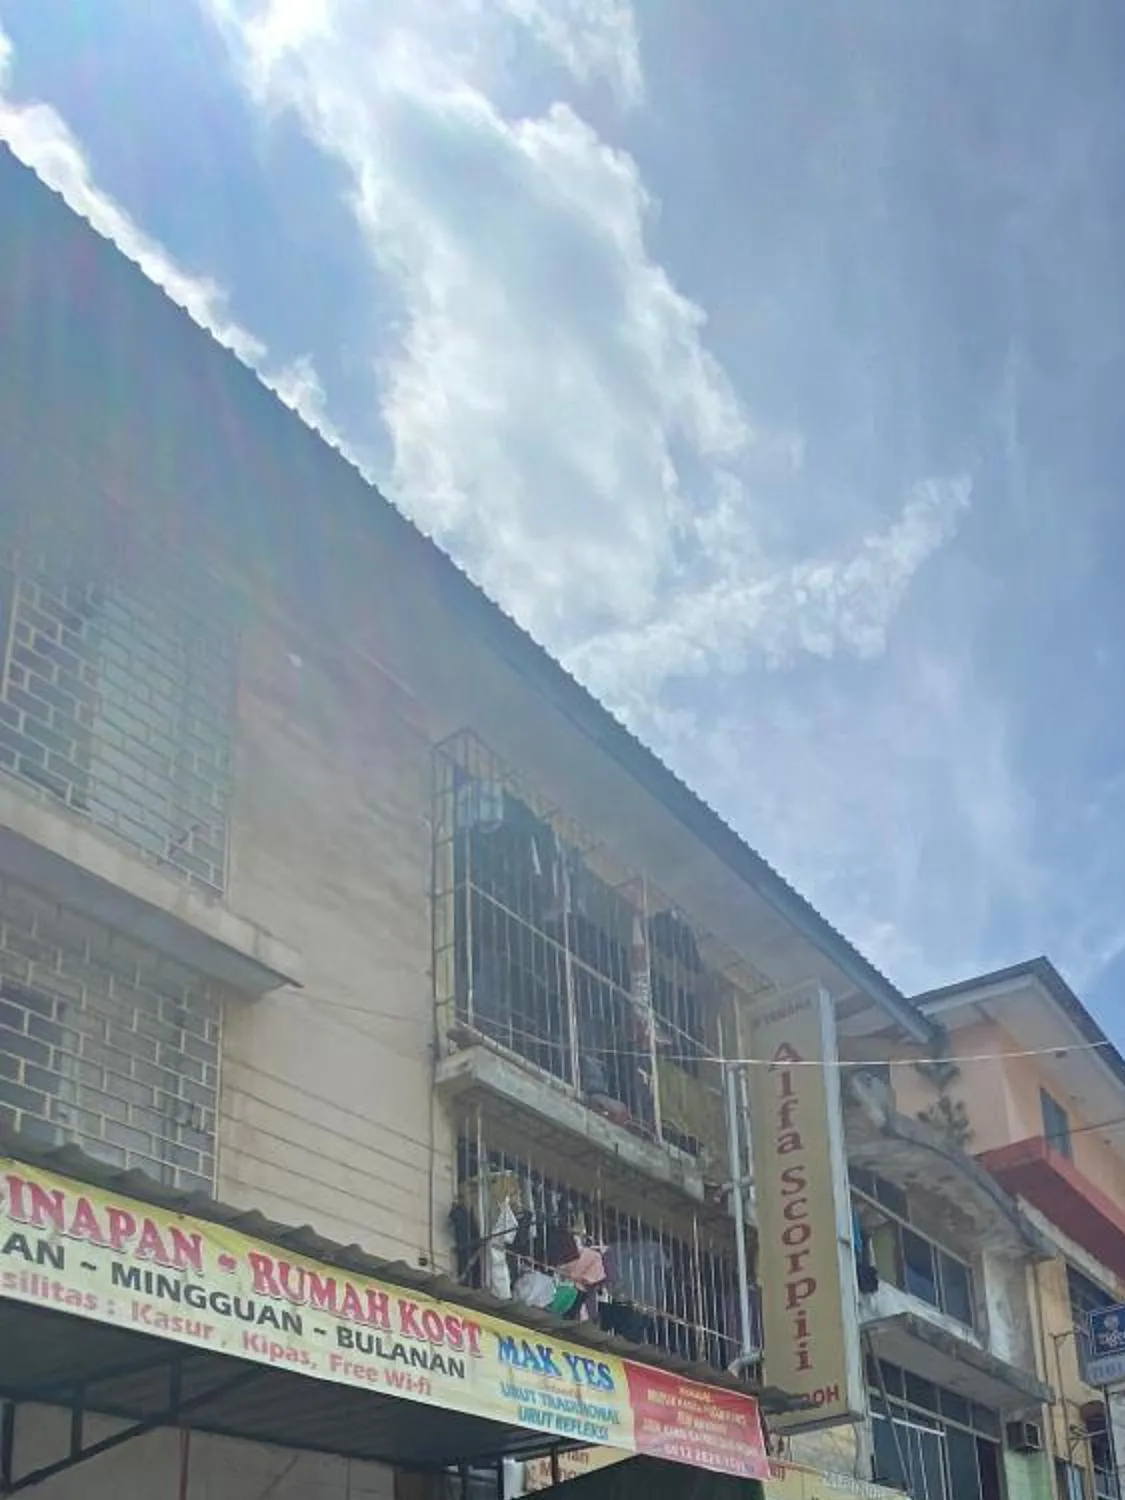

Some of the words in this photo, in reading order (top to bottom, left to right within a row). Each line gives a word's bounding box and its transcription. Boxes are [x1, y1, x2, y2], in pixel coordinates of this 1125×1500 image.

[0, 1172, 205, 1276] INAPAN
[249, 1251, 392, 1333] RUMAH
[397, 1299, 483, 1358] KOST
[111, 1261, 303, 1336] MINGGUAN
[336, 1326, 465, 1379] BULANAN
[497, 1335, 562, 1377] MAK
[562, 1351, 616, 1392] YES
[330, 1352, 379, 1383] Free
